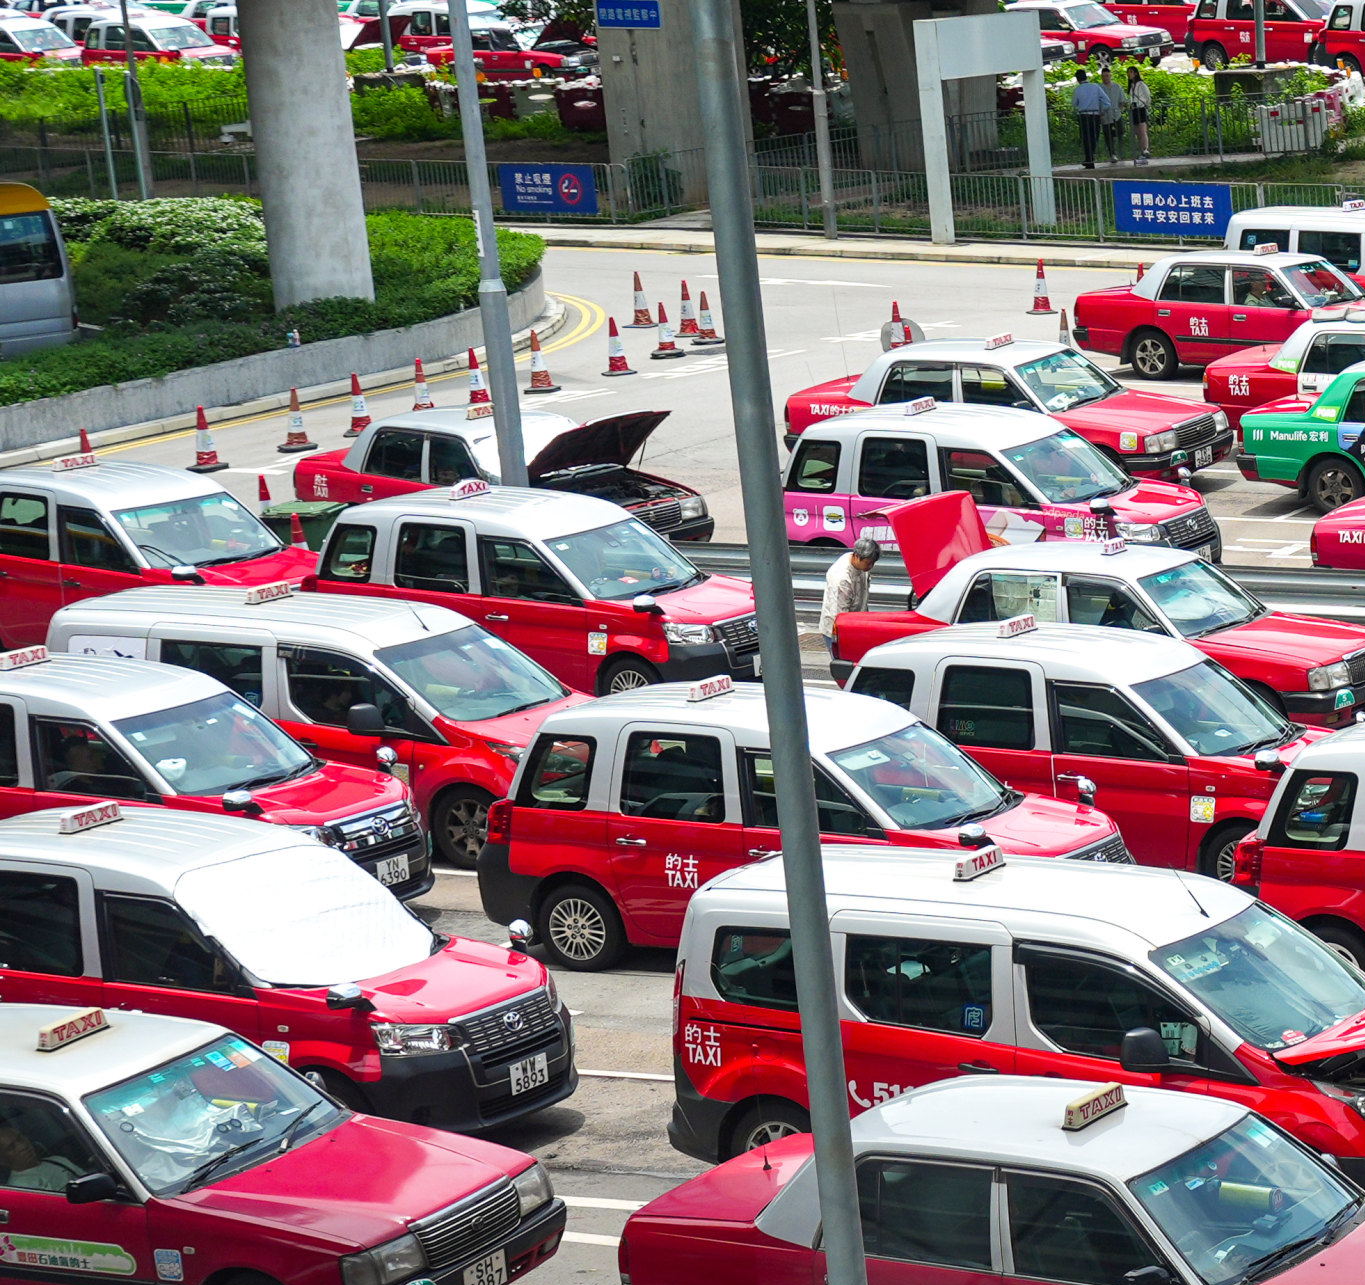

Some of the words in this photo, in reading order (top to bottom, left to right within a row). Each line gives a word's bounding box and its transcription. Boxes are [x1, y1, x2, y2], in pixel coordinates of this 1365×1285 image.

[514, 173, 552, 185] 禁止吸煙
[516, 185, 526, 193] No
[527, 186, 552, 195] smoking
[1131, 193, 1214, 209] 開開心心上班去
[1132, 209, 1215, 225] 平平安安回家來
[1190, 317, 1207, 326] 的士
[1191, 326, 1208, 336] TAXI
[1229, 375, 1249, 385] 的士
[1229, 385, 1250, 396] TAXI
[810, 405, 829, 415] TAXI
[1270, 431, 1308, 441] Manulife
[1309, 431, 1329, 442] 宏利
[61, 454, 96, 468] TAXI
[314, 474, 328, 486] 的士
[461, 480, 487, 495] TAXI
[313, 486, 329, 498] TAXI
[1084, 517, 1108, 530] 的士
[1084, 530, 1109, 542] TAXI
[1338, 530, 1363, 544] TAXI
[257, 583, 289, 599] TAXI
[1009, 619, 1035, 633] TAXI
[8, 647, 47, 665] TAXI
[700, 677, 732, 696] TAXI
[74, 804, 119, 827] TAXI
[386, 858, 400, 870] YN
[665, 853, 699, 871] 的士
[972, 851, 997, 871] TAXI
[381, 870, 407, 886] 6390
[664, 870, 699, 889] TAXI
[53, 1010, 102, 1042] TAXI
[685, 1023, 721, 1046] 的士
[684, 1044, 722, 1066] TAXI
[521, 1057, 539, 1073] WW
[515, 1068, 546, 1093] 5893
[1080, 1087, 1122, 1120] TAXI
[17, 1251, 91, 1269] 豐田石油氣的士
[475, 1257, 493, 1274] SH
